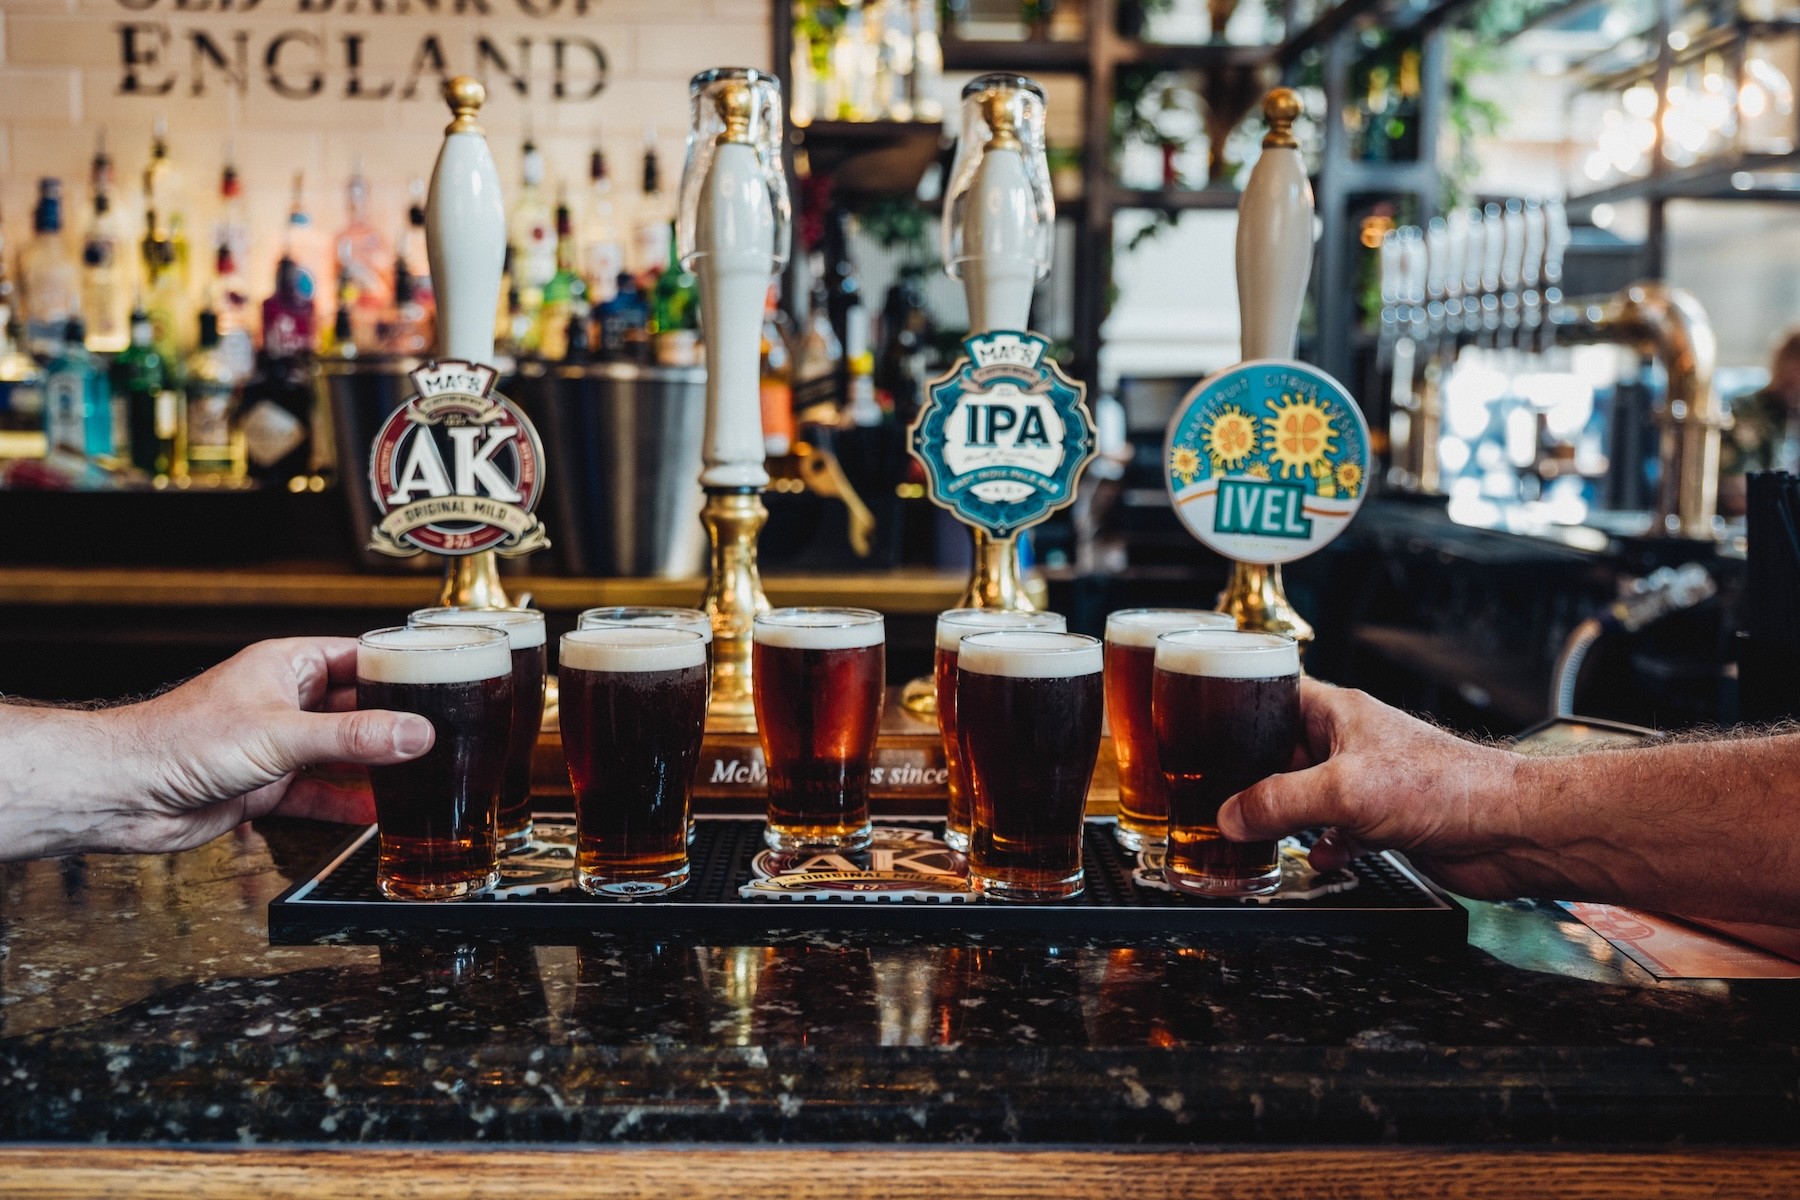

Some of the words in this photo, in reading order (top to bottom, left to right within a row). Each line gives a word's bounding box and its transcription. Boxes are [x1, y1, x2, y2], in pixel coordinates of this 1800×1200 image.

[113, 20, 609, 100] ENGLAND
[1264, 374, 1319, 398] CITRUS
[965, 404, 1052, 448] IPA
[386, 424, 524, 505] AK
[404, 501, 466, 523] ORIGINAL
[473, 502, 509, 521] MILD
[1220, 484, 1305, 534] IVEL
[888, 762, 949, 785] since
[779, 849, 958, 875] AK
[800, 871, 882, 881] ORIGINAL
[893, 873, 938, 882] MILD
